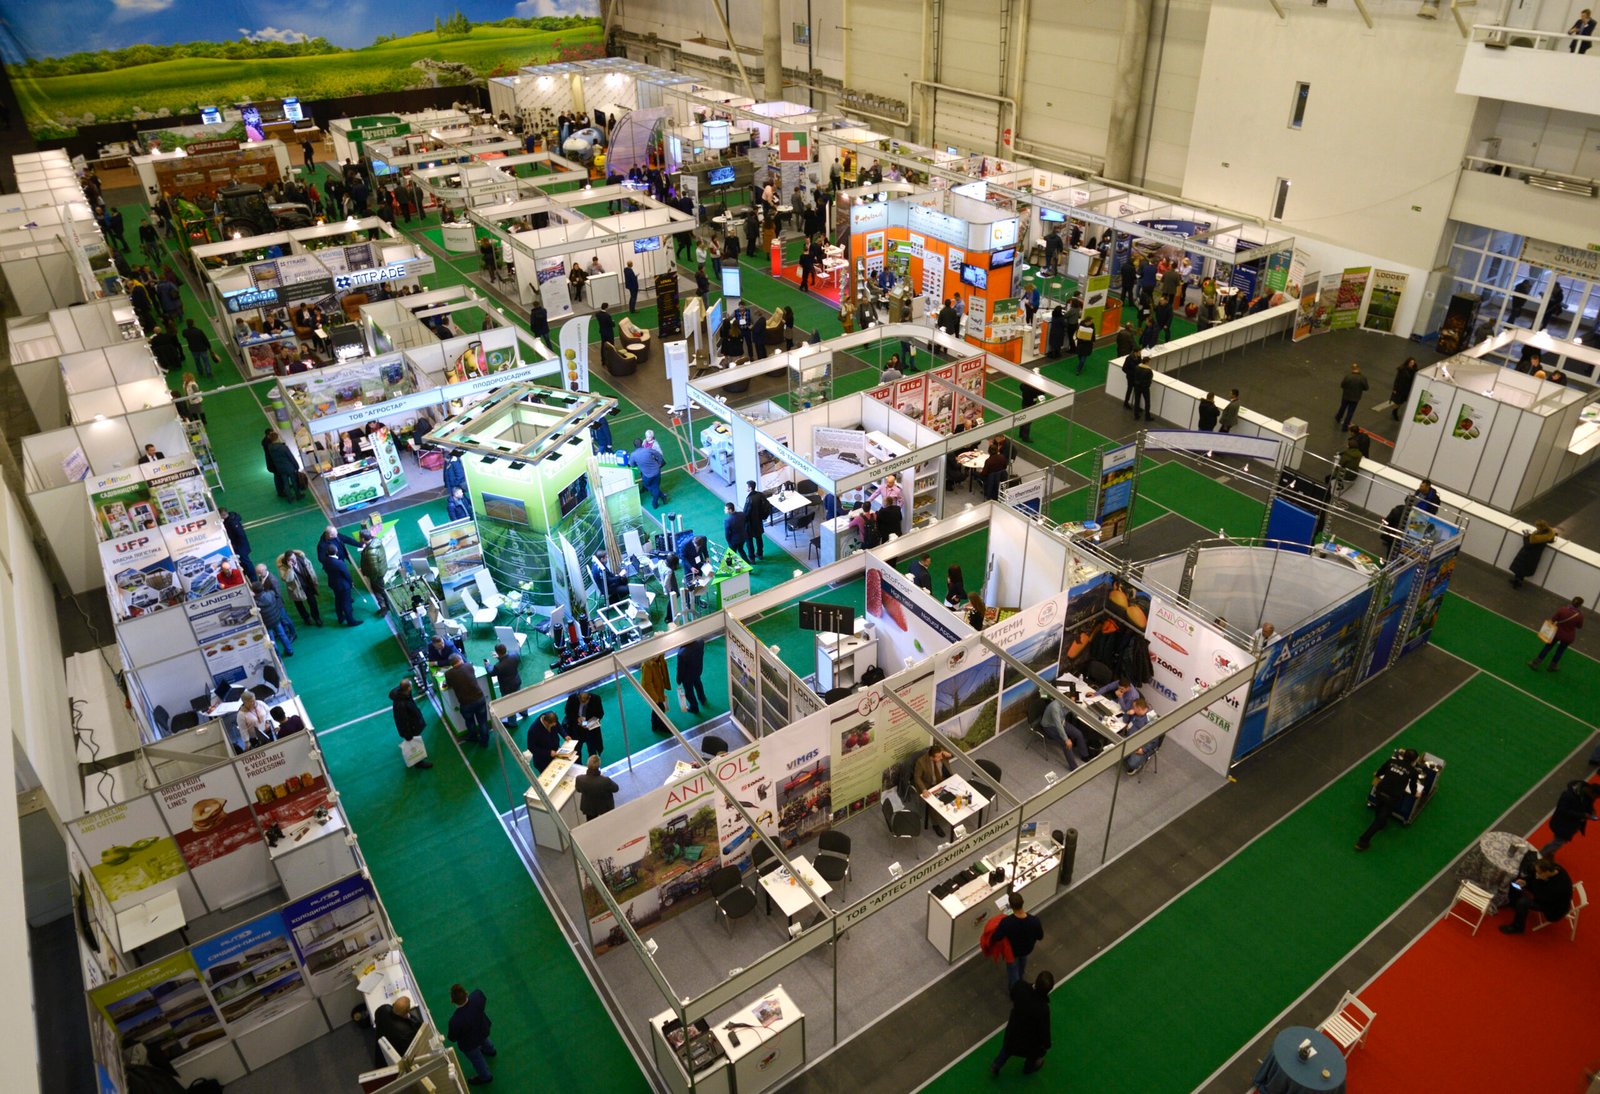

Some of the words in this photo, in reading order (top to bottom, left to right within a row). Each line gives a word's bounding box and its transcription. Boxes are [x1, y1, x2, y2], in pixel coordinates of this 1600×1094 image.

[353, 265, 407, 286] TTRADE
[200, 590, 243, 608] UNIDEX
[1157, 656, 1184, 679] zanon
[241, 751, 267, 765] TOMATO
[251, 752, 285, 770] VEGETABLE
[786, 748, 819, 771] VIMAS
[246, 759, 287, 780] PROCESSING
[163, 783, 207, 804] PRODUCTION
[166, 798, 188, 810] LINES
[845, 905, 867, 923] ТОВ
[869, 881, 907, 907] "АРТЕС
[909, 843, 972, 886] ПОЛІТЕХНІКА
[972, 816, 1015, 847] УКРАЇНА"
